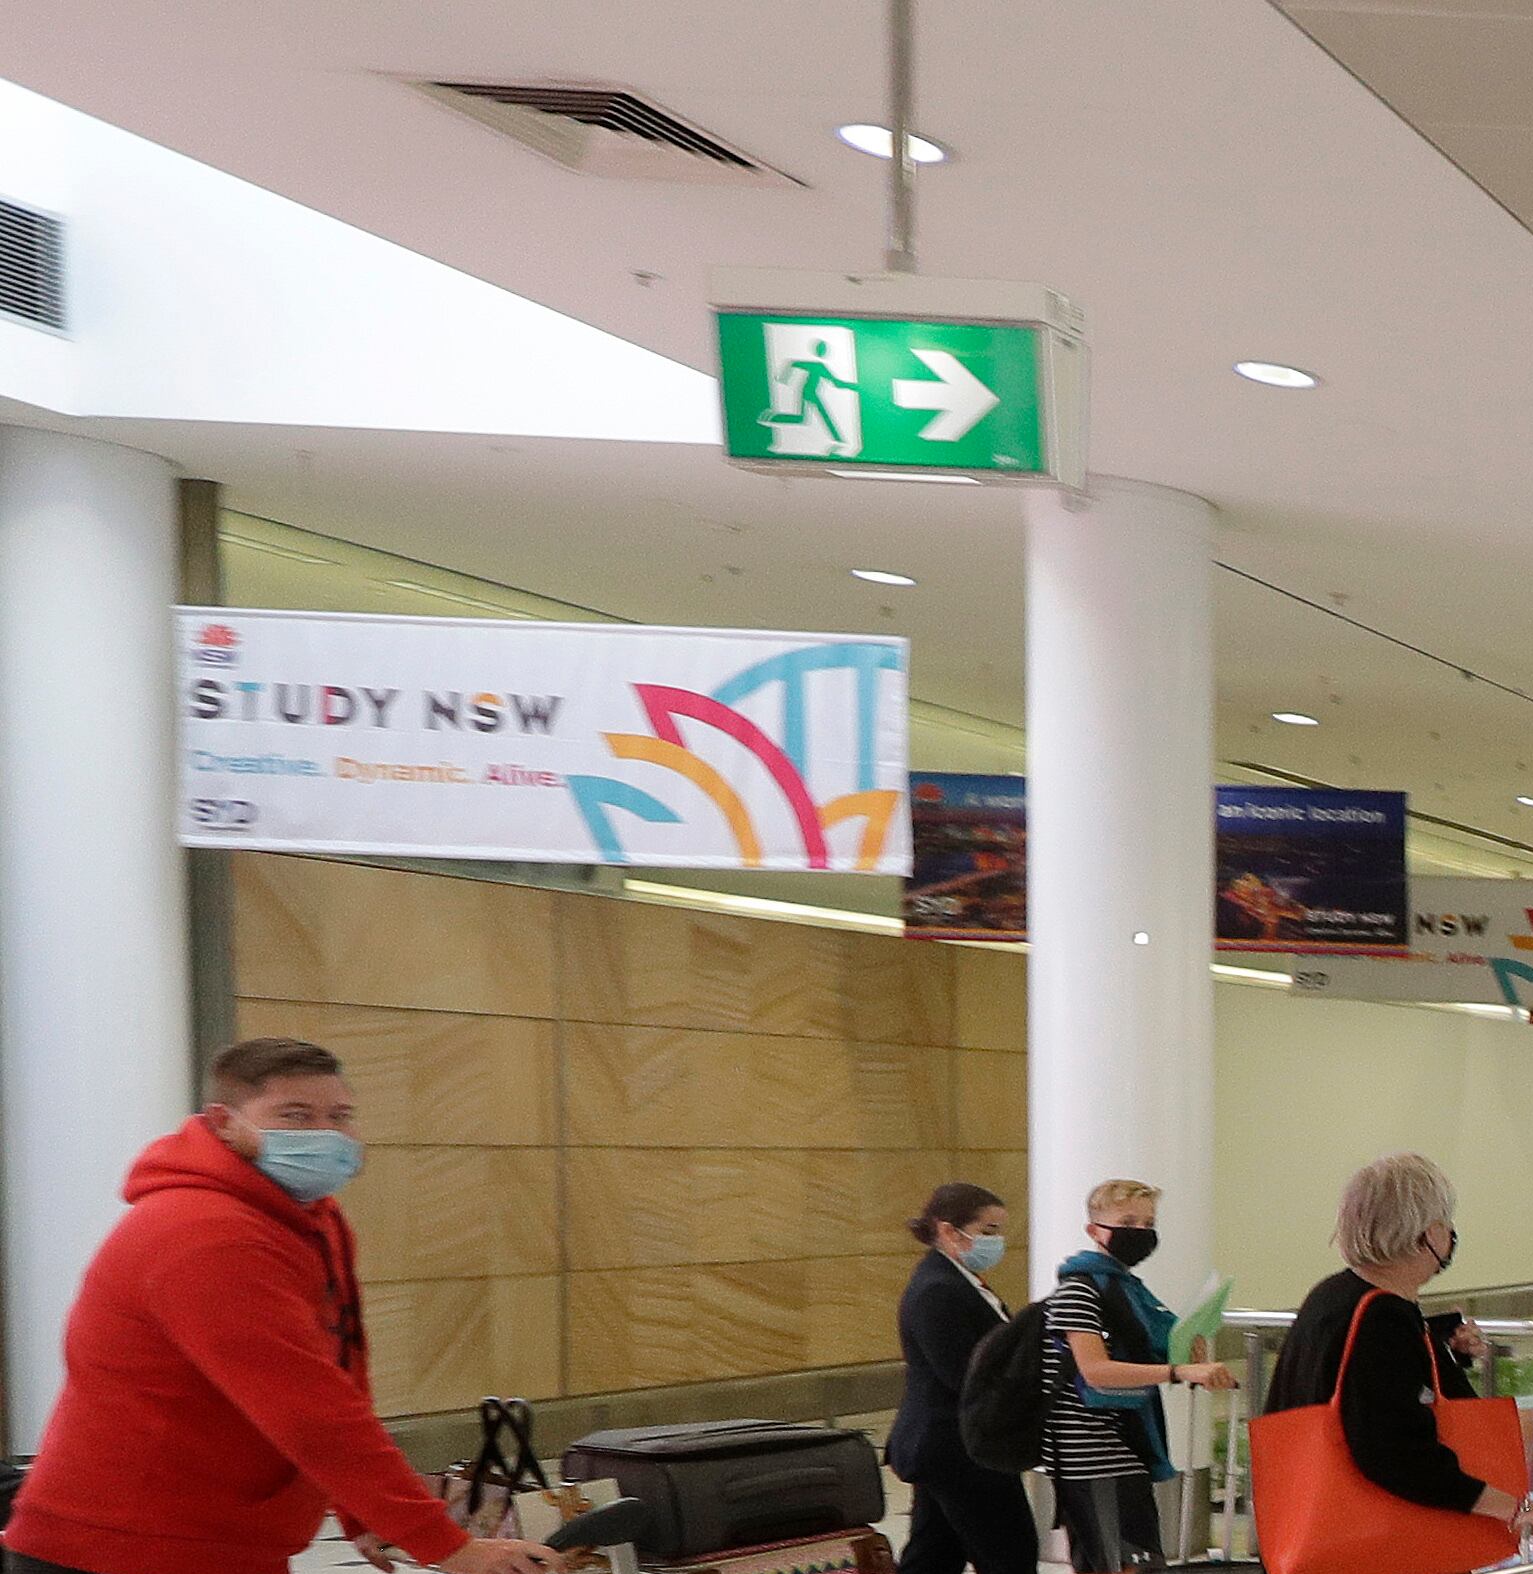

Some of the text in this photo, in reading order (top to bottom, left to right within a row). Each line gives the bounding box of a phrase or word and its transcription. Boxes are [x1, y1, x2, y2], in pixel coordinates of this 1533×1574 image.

[189, 678, 566, 733] STUDY NSW
[335, 755, 476, 785] Dynamic.
[1307, 803, 1386, 824] location
[1414, 912, 1489, 937] NSW
